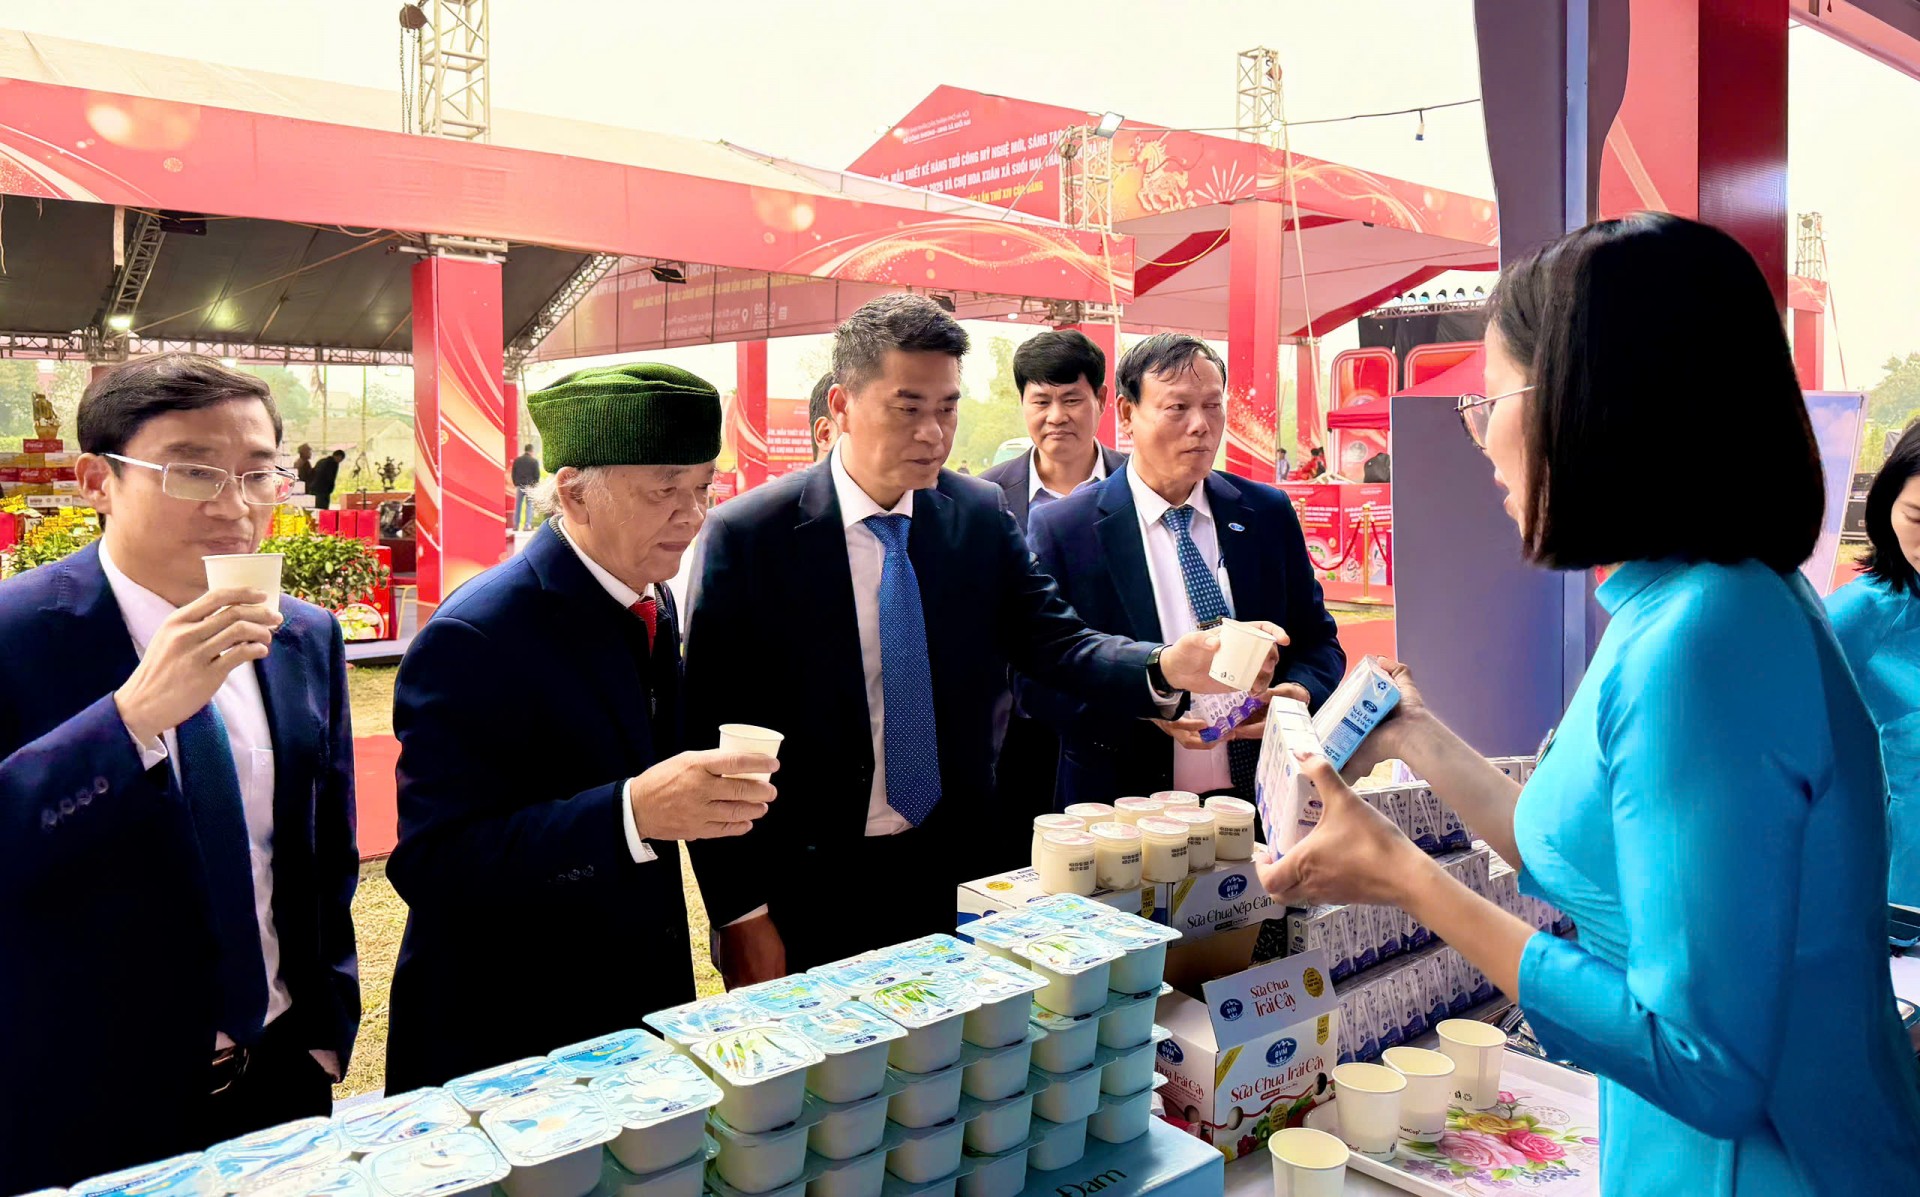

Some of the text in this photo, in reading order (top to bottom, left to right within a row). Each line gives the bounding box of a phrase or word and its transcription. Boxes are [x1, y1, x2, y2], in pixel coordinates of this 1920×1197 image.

[905, 164, 920, 180] THIẾT
[922, 160, 930, 176] KẾ
[930, 158, 948, 174] HÀNG
[948, 152, 960, 168] THỦ
[962, 150, 979, 166] CÔNG
[980, 146, 990, 162] MỸ
[991, 140, 1010, 158] NGHỆ
[1028, 132, 1048, 150] SÁNG
[944, 176, 953, 190] VÀ
[954, 173, 966, 189] CHỢ
[967, 172, 980, 186] HOA
[982, 166, 1000, 182] XUÂN
[1000, 163, 1010, 178] XÃ
[1012, 156, 1028, 176] SUỐI
[1187, 914, 1206, 929] Sữa
[1207, 909, 1232, 922] Chua
[1232, 900, 1252, 915] Nếp
[1250, 980, 1290, 999] Sữa Chua
[1252, 992, 1296, 1017] Trái Cây
[1274, 1047, 1288, 1058] BVM
[1156, 1062, 1204, 1100] hua Trái Cây
[1230, 1084, 1252, 1102] Sữa
[1254, 1074, 1284, 1093] Chua
[1288, 1061, 1304, 1081] Trái
[1304, 1056, 1324, 1073] Cây
